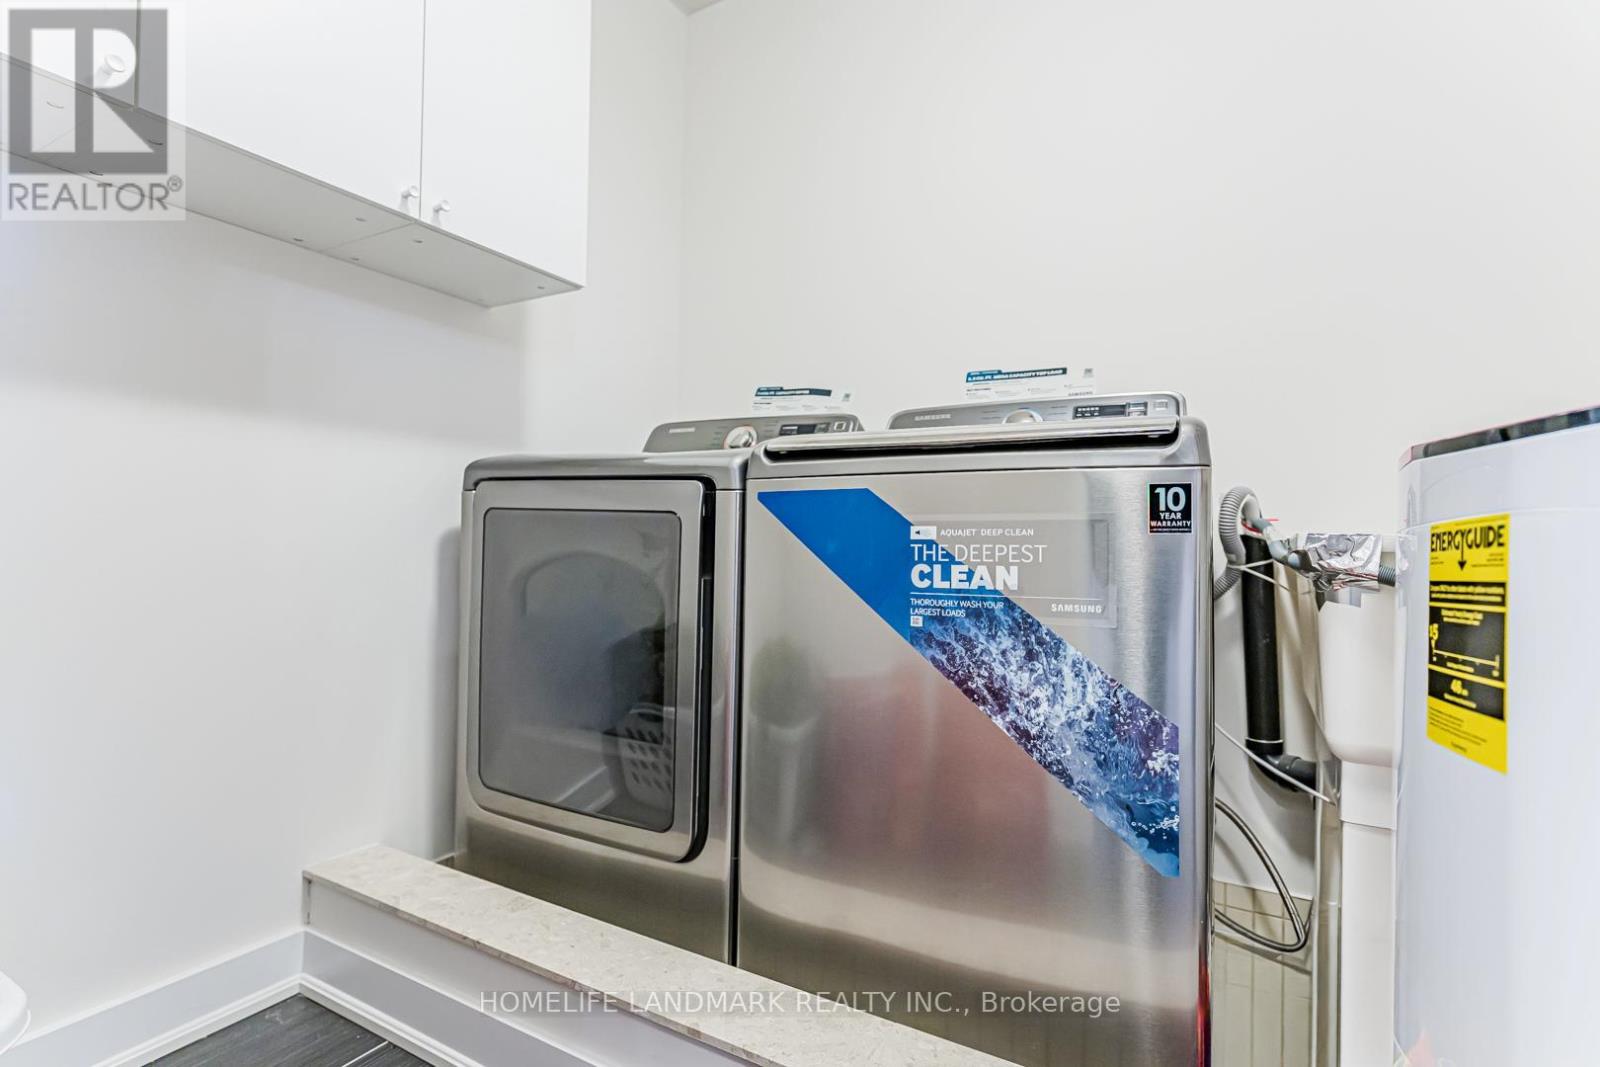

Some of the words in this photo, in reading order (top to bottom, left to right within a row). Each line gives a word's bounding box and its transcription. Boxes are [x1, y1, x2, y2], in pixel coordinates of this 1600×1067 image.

[1154, 486, 1187, 512] 10
[1160, 512, 1182, 520] YEAR
[940, 528, 974, 537] AQUAJET
[980, 528, 1003, 537] DEEP
[1004, 528, 1034, 537] CLEAN
[910, 544, 949, 562] THE
[954, 544, 1048, 563] DEEPEST
[911, 563, 1018, 591] CLEAN
[911, 598, 958, 608] THOROUGHLY
[960, 600, 981, 609] WASH
[983, 601, 1005, 610] YOUR
[1051, 603, 1103, 614] SAMSUNG
[910, 608, 940, 617] LARGEST
[941, 609, 966, 617] LOADS
